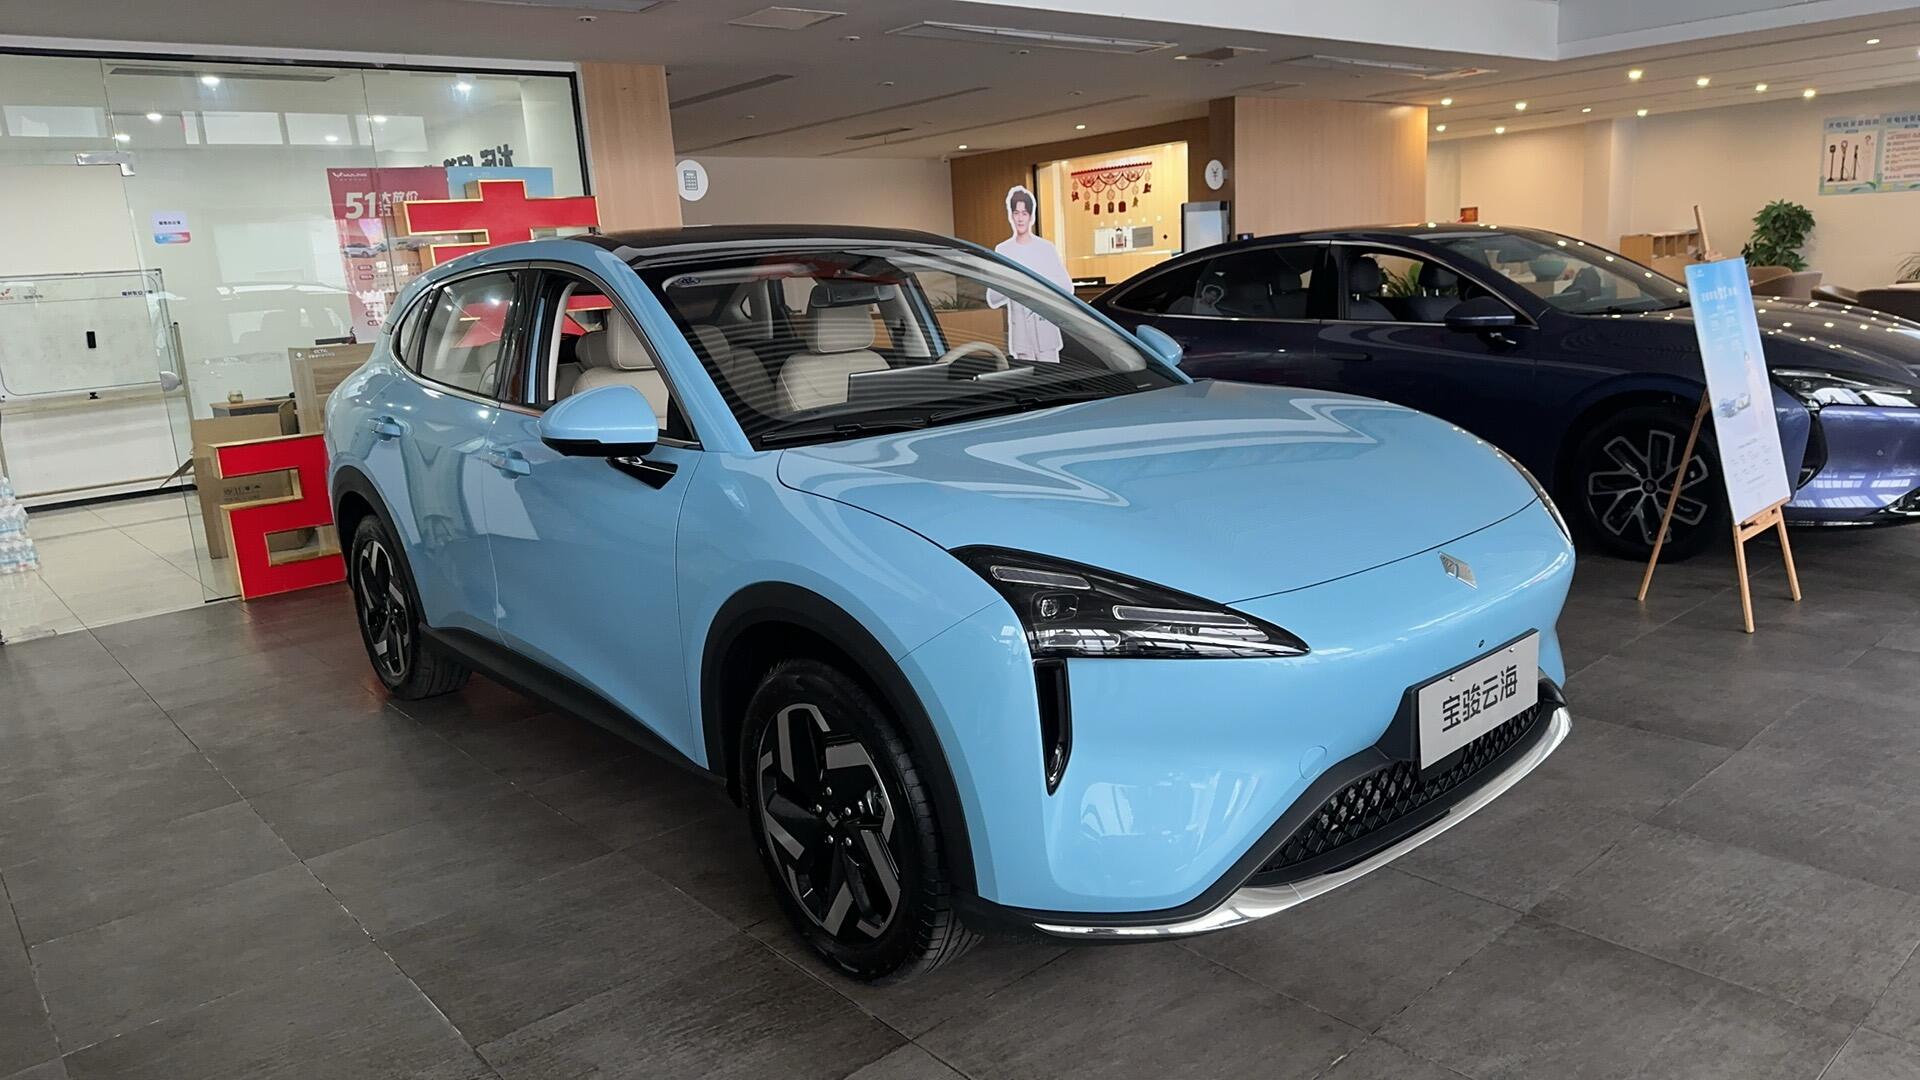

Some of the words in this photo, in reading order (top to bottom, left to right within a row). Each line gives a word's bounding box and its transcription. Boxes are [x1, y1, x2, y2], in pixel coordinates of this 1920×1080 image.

[345, 191, 377, 219] 51
[1441, 664, 1518, 733] 宝骏云海
